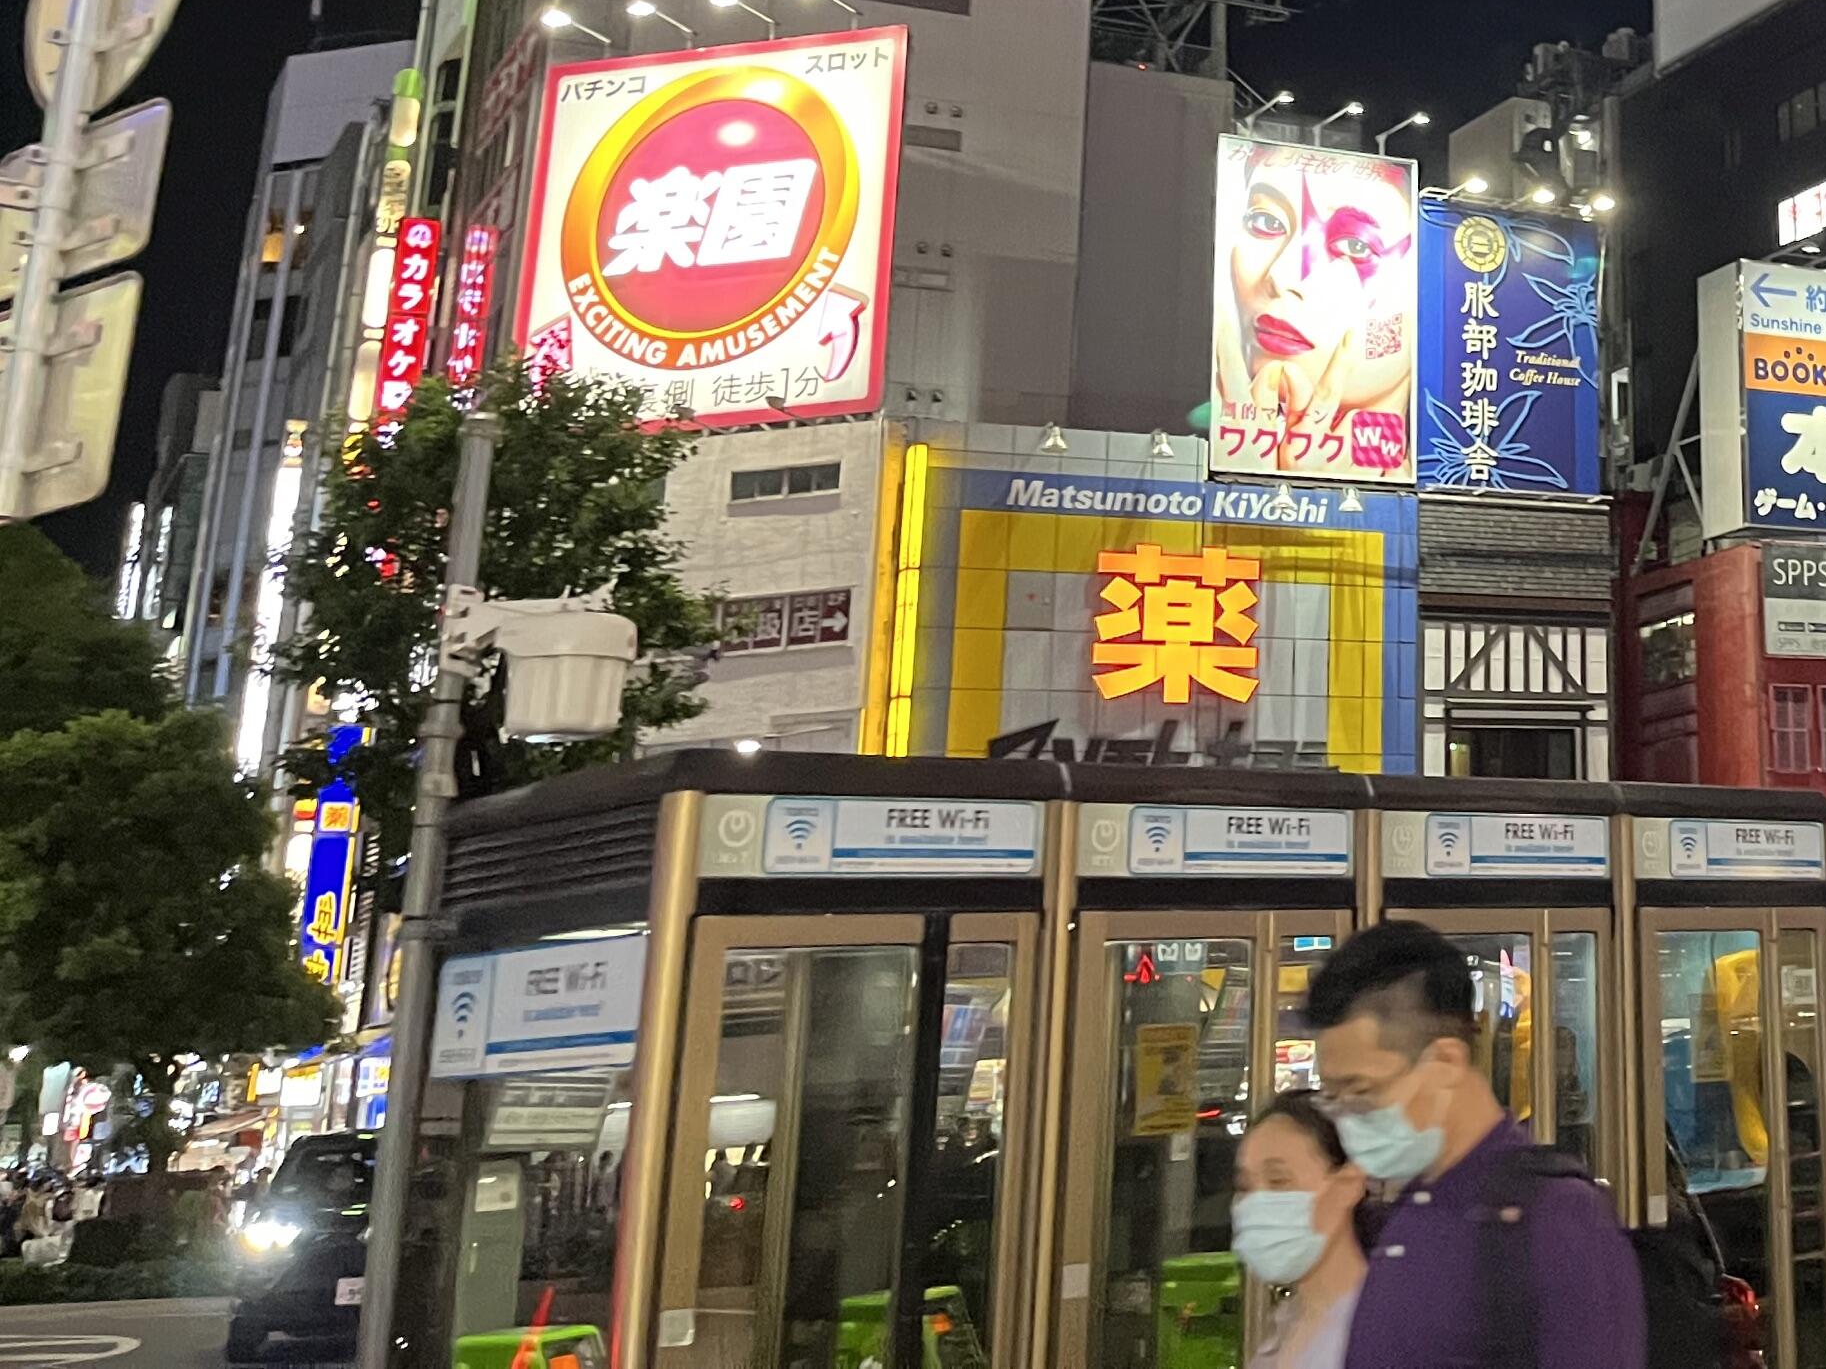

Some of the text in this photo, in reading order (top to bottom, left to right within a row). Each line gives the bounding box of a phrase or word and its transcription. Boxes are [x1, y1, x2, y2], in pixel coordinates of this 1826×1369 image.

[804, 46, 892, 75] スロット
[559, 73, 647, 104] パチンコ
[600, 157, 818, 278] 楽園
[568, 272, 668, 367] EXCITING
[675, 245, 840, 368] AMUSEMENT
[1750, 312, 1822, 336] Sunshine
[1459, 280, 1500, 482] 服部珈琲舎
[1508, 367, 1582, 387] Coffee House
[1219, 425, 1345, 464] ワクワク
[1005, 478, 1203, 517] Matsumoto
[1090, 543, 1261, 705] 薬
[885, 808, 990, 830] FREE Wi-Fi
[1226, 815, 1311, 837] FREE Wi-Fi
[1504, 822, 1575, 841] FREE Wi-Fi
[1735, 827, 1795, 845] FREE Wi-Fi
